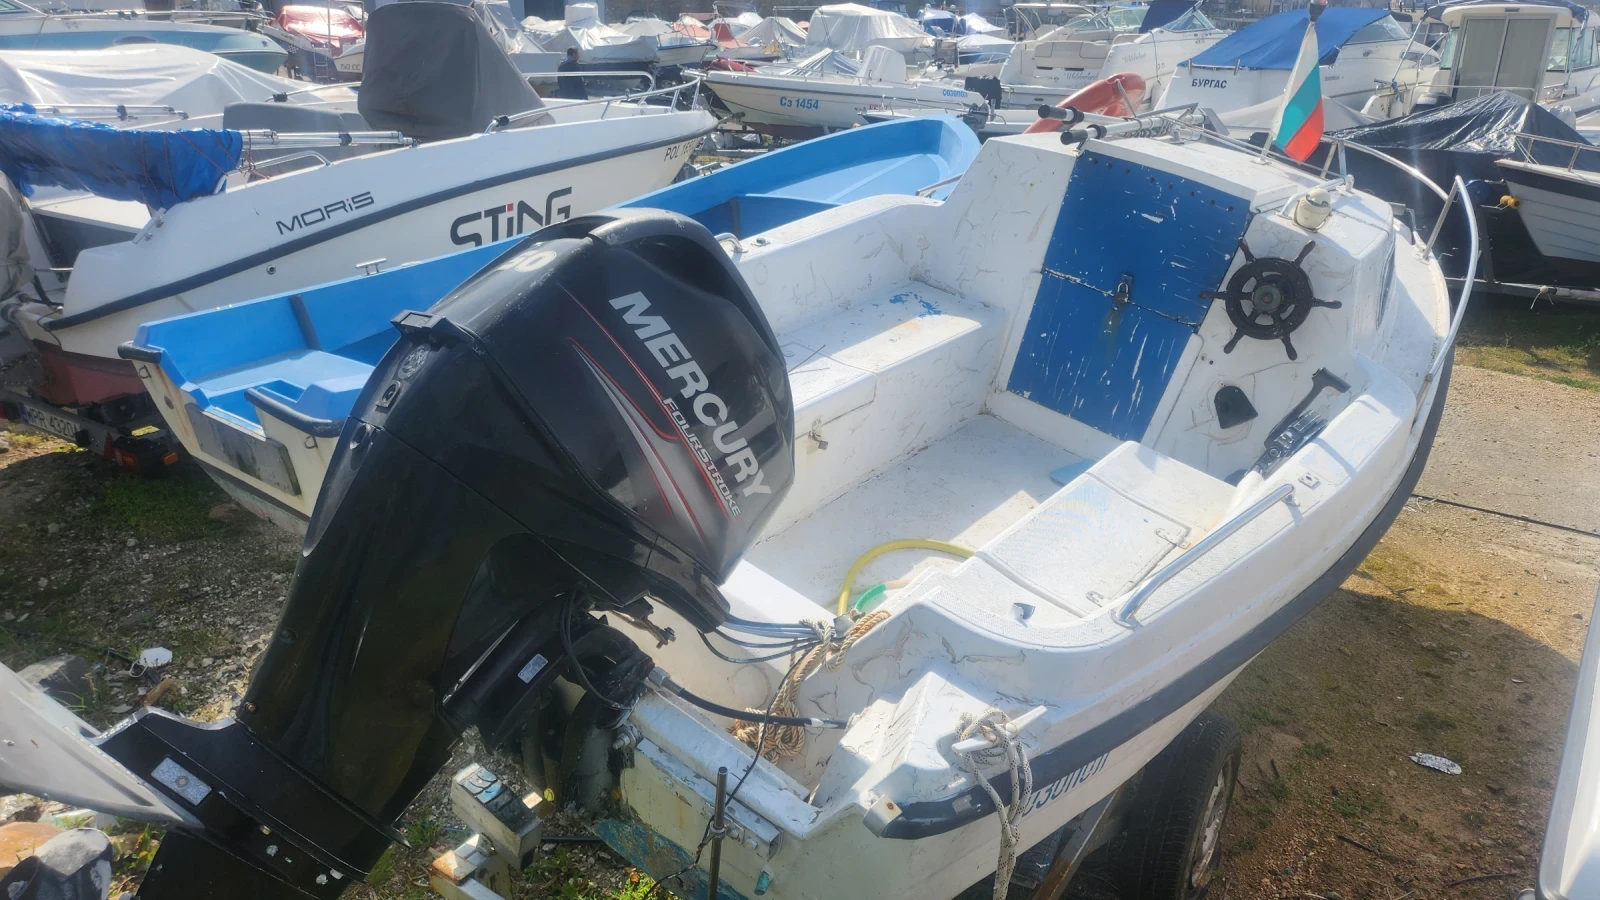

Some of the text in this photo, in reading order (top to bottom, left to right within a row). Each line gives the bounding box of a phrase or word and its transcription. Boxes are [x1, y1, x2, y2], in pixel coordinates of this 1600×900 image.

[796, 98, 819, 109] 1454
[1191, 78, 1228, 89] БУРГАС
[608, 291, 771, 497] MERCURY
[662, 397, 742, 517] FOURSTROKE
